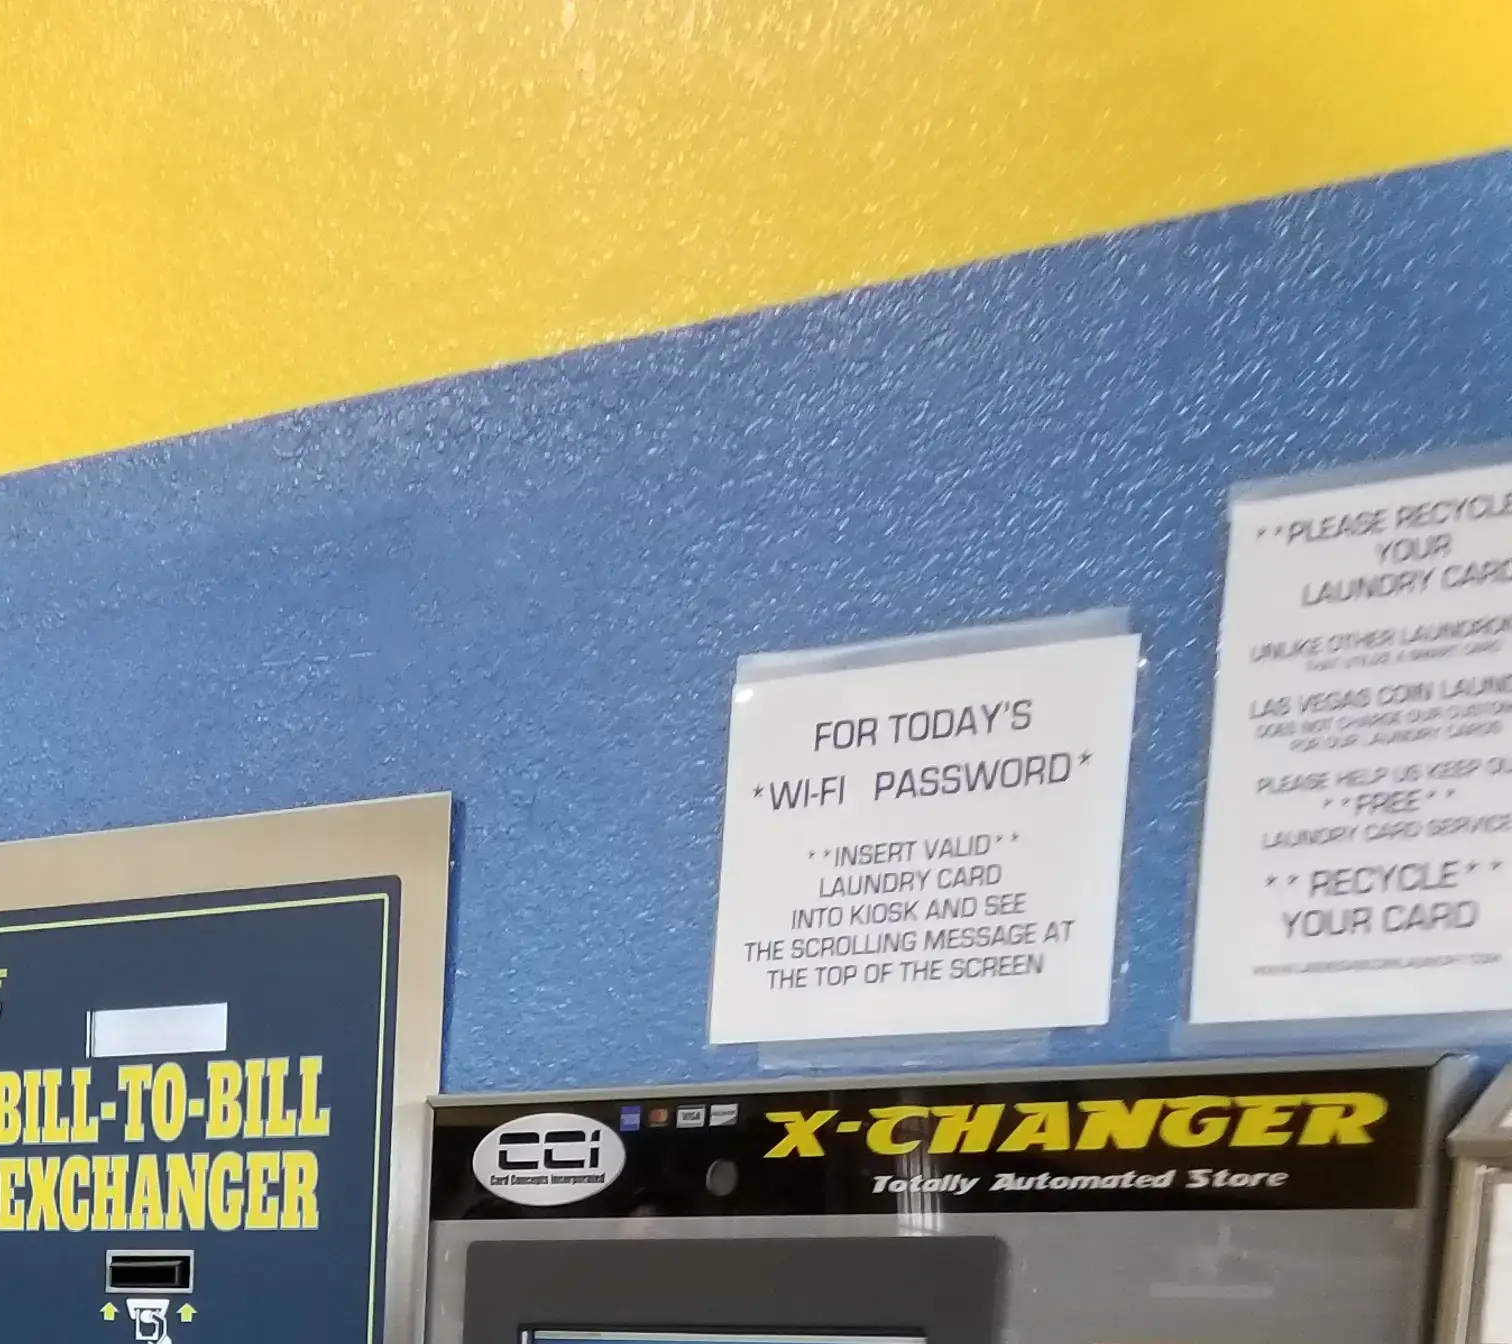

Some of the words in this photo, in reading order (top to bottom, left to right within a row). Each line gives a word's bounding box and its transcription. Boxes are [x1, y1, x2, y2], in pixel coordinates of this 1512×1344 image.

[1376, 533, 1453, 565] YOUR
[1301, 567, 1436, 608] LAUNDRY
[814, 718, 878, 752] FOR
[888, 699, 1033, 744] TODAY'S
[1261, 825, 1359, 850] LAUNDRY
[819, 871, 930, 898] LAUNDRY
[937, 864, 1002, 888] CARD
[791, 905, 843, 930] INTO
[850, 901, 919, 927] KIOSK
[925, 897, 977, 920] AND
[984, 893, 1026, 917] SEE
[1282, 906, 1372, 939] YOUR
[1382, 900, 1479, 933] CARD
[745, 940, 784, 963] THE
[790, 931, 916, 959] SCROLLING
[924, 923, 1038, 952] MESSAGE
[1043, 920, 1076, 944] AT
[767, 969, 807, 991] THE
[816, 966, 858, 988] TOP
[864, 963, 892, 985] OF
[899, 961, 942, 983] THE
[949, 953, 1045, 981] SCREEN
[762, 1091, 1388, 1160] X-CHANGER
[871, 1173, 980, 1196] Totally
[988, 1169, 1176, 1191] Automated
[1183, 1168, 1290, 1189] Store
